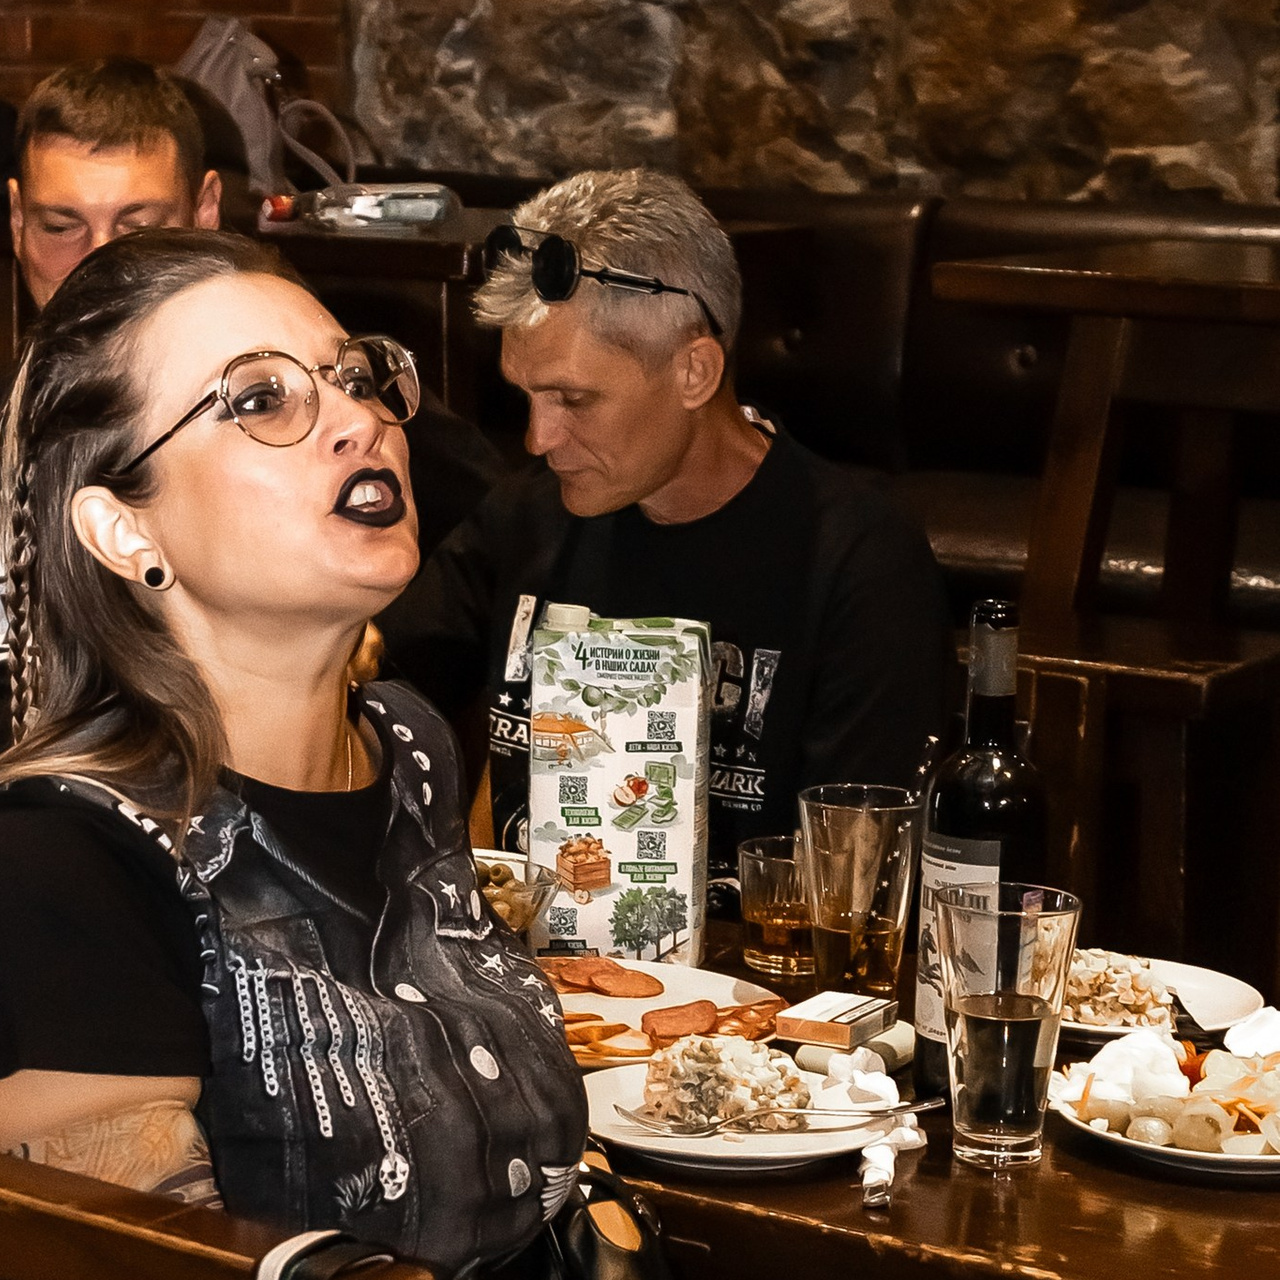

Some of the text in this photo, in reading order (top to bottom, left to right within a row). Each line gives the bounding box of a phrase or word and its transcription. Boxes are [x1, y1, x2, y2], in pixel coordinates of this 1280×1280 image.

[575, 641, 660, 670] 4 ИСТОРИИ О ЖИЗНИ
[595, 659, 600, 671] В
[629, 661, 657, 673] САДАХ
